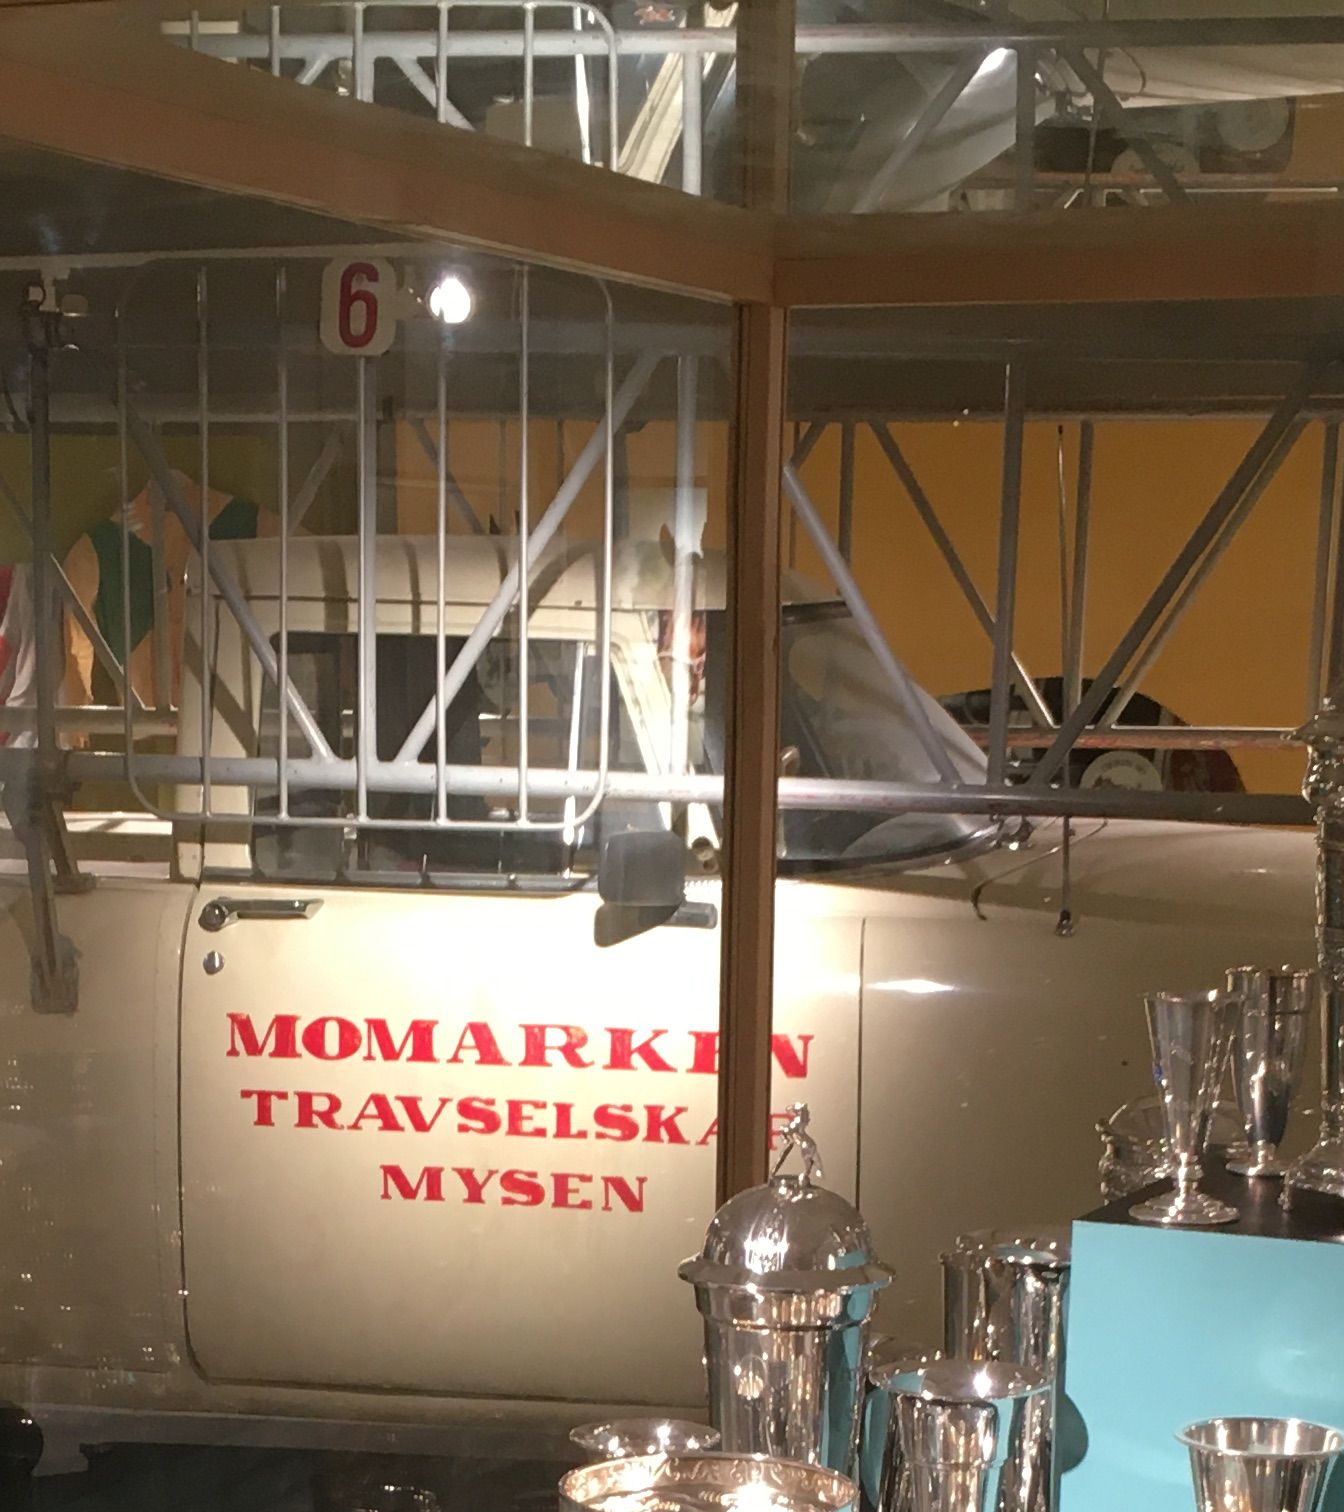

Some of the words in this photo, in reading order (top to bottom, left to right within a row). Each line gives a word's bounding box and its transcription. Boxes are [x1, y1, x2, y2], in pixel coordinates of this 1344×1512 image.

[339, 262, 379, 348] 6
[226, 1012, 814, 1079] MOMARKEN
[379, 1163, 647, 1213] MYSEN
